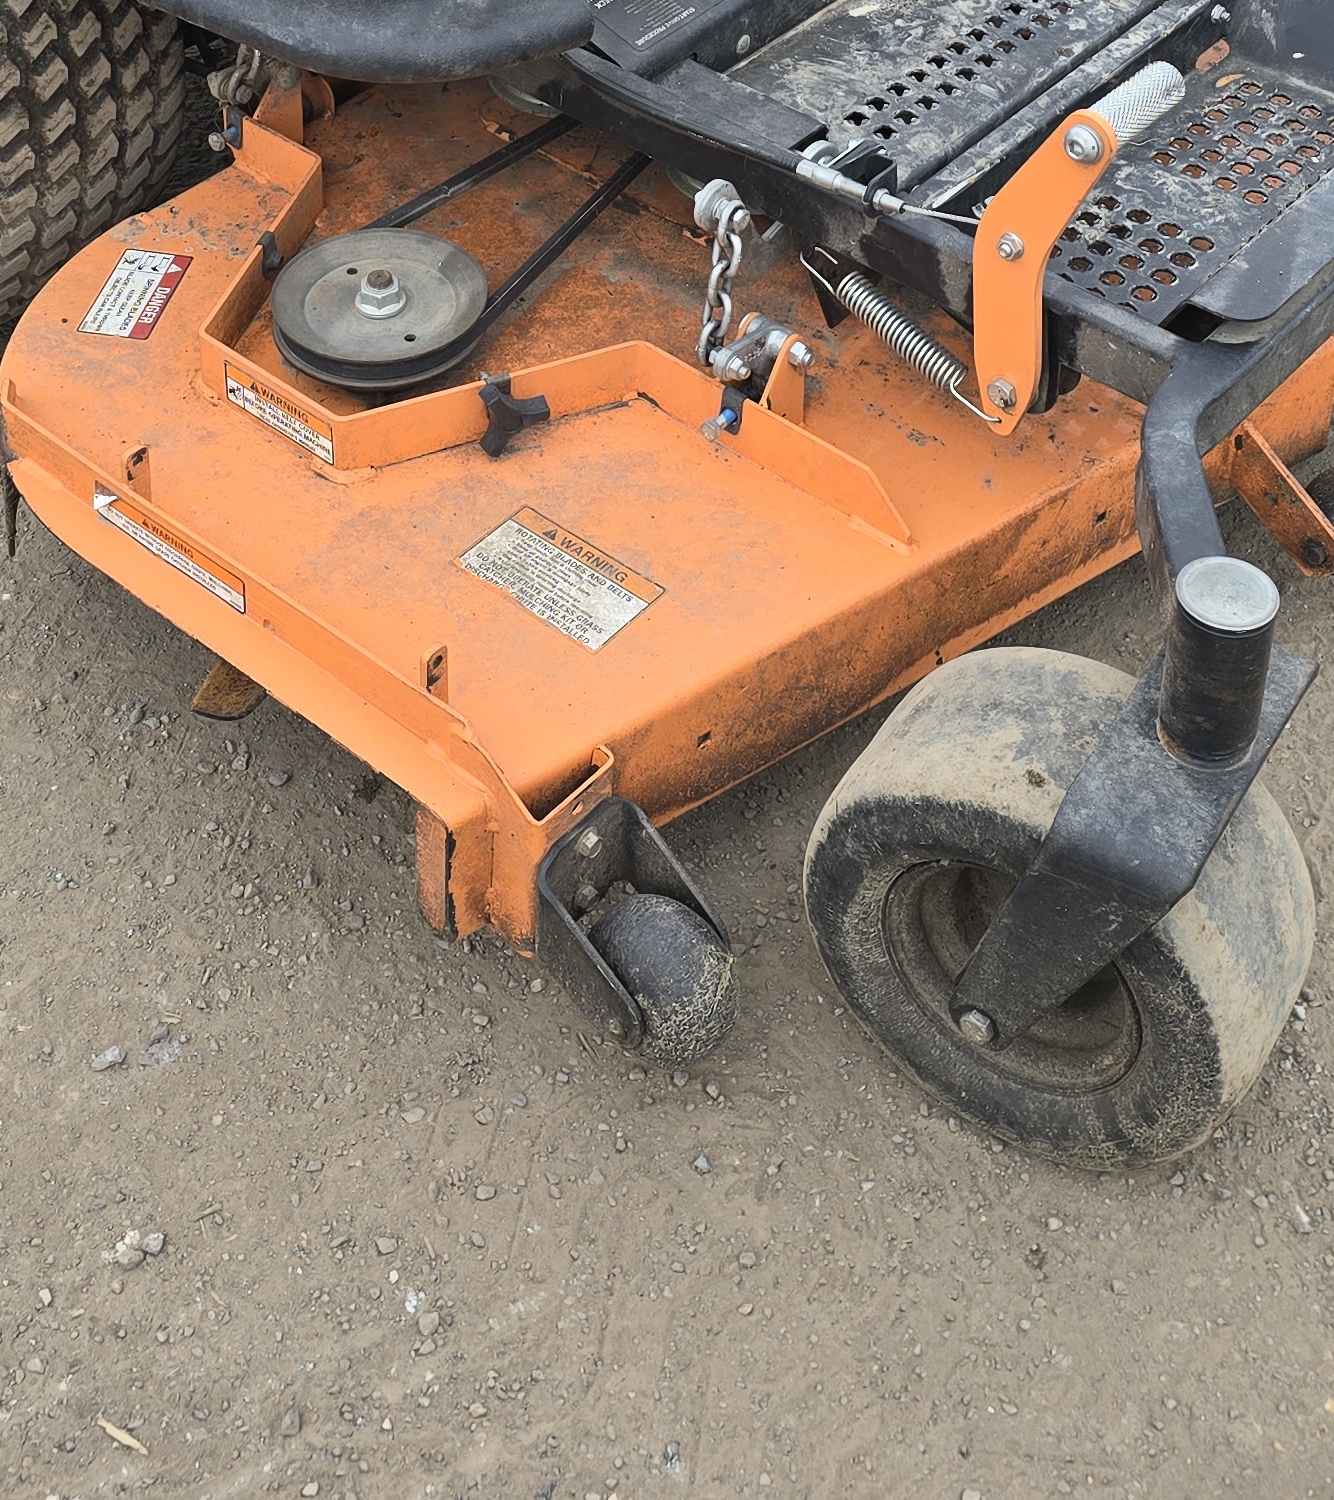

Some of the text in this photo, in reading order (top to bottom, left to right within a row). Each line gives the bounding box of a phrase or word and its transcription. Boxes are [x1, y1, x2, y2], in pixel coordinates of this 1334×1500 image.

[118, 307, 138, 330] BLADES
[137, 286, 171, 323] DANGER
[260, 385, 308, 424] WARNING
[151, 523, 193, 559] WARNING
[556, 536, 631, 583] WARNING
[513, 527, 635, 603] ROTATING BLADES AND BELTS
[475, 552, 604, 634] DO NOT OPERATE UNLESS GRASS
[477, 562, 589, 634] CATCHER, MULCHING KIT OR
[535, 607, 547, 616] IS
